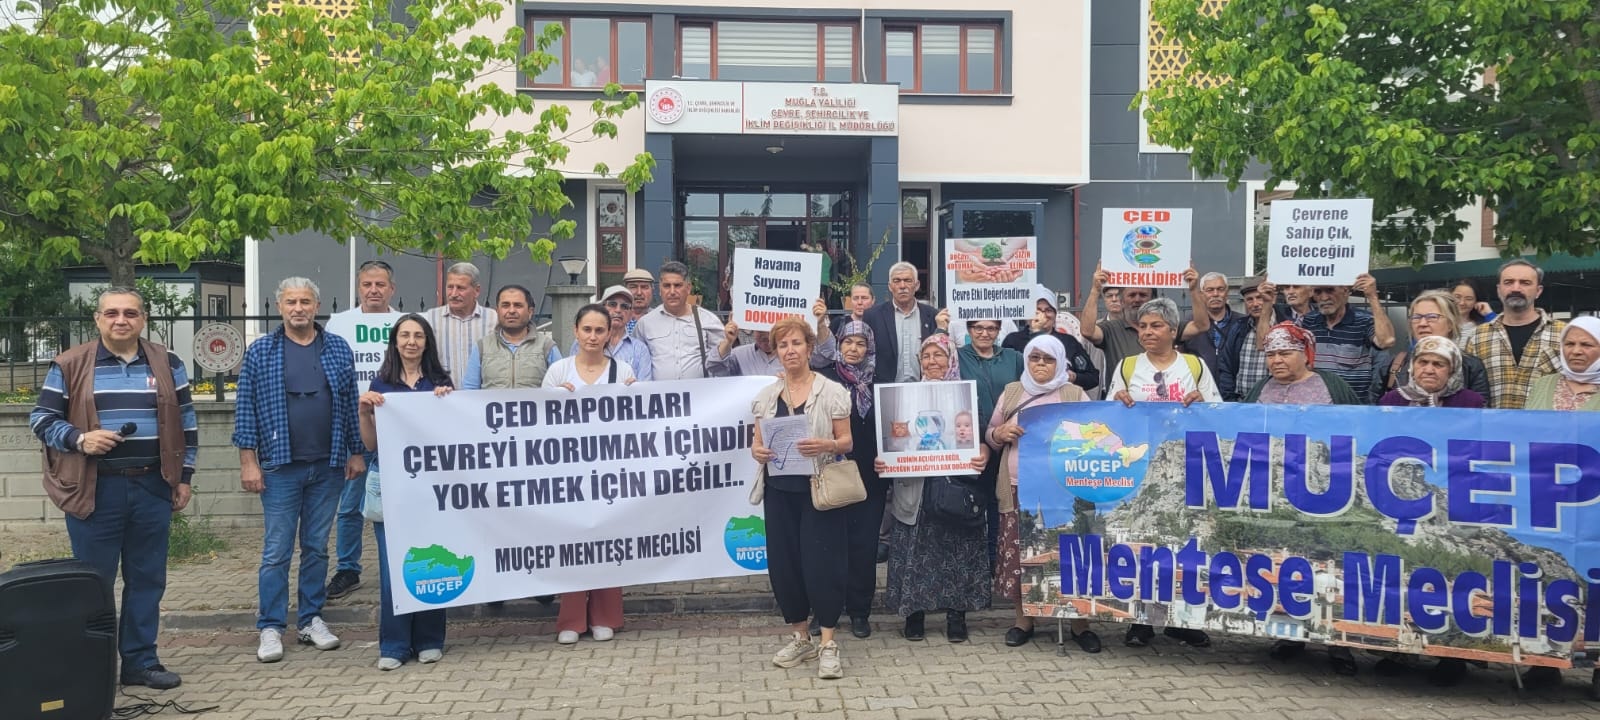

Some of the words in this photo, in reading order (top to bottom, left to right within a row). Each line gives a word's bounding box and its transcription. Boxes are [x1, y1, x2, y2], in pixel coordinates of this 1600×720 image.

[785, 98, 816, 107] MUĞLA
[858, 110, 869, 119] VE
[745, 118, 771, 129] İKLİM
[1123, 210, 1171, 225] ÇED
[1292, 207, 1349, 223] Çevrene
[1286, 226, 1325, 240] Sahip
[1327, 226, 1352, 241] Çık,
[1281, 245, 1356, 259] Geleceğini
[754, 256, 802, 273] Havama
[1298, 263, 1335, 277] Koru!
[753, 274, 801, 291] Suyuma
[1106, 270, 1184, 287] GEREKLİDİR!
[744, 291, 808, 309] Toprağıma
[952, 288, 970, 303] Çevre
[971, 287, 983, 301] Etki
[983, 285, 1030, 302] Değerlendirme
[745, 309, 805, 324] DOKUN!
[355, 323, 392, 345] Doğ
[354, 350, 381, 363] iras
[485, 401, 537, 434] ÇED
[545, 391, 692, 426] RAPORLARI
[403, 435, 518, 479] ÇEVREYİ
[525, 431, 659, 466] KORUMAK
[1064, 459, 1121, 478] MUÇEP
[432, 482, 490, 511] YOK
[496, 475, 585, 508] ETMEK
[590, 467, 647, 505] İÇİN
[653, 460, 744, 496] DEĞİL!..
[1065, 476, 1102, 489] Menteşe
[1103, 476, 1134, 488] Meclisi
[1184, 431, 1600, 536] MUÇEP
[495, 545, 555, 574] MUÇEP
[559, 537, 634, 566] MENTEŞE
[637, 525, 702, 559] MECLİSİ
[415, 580, 463, 596] MUÇEP
[1058, 533, 1319, 624] Menteşe
[1342, 550, 1600, 646] Meclisi
